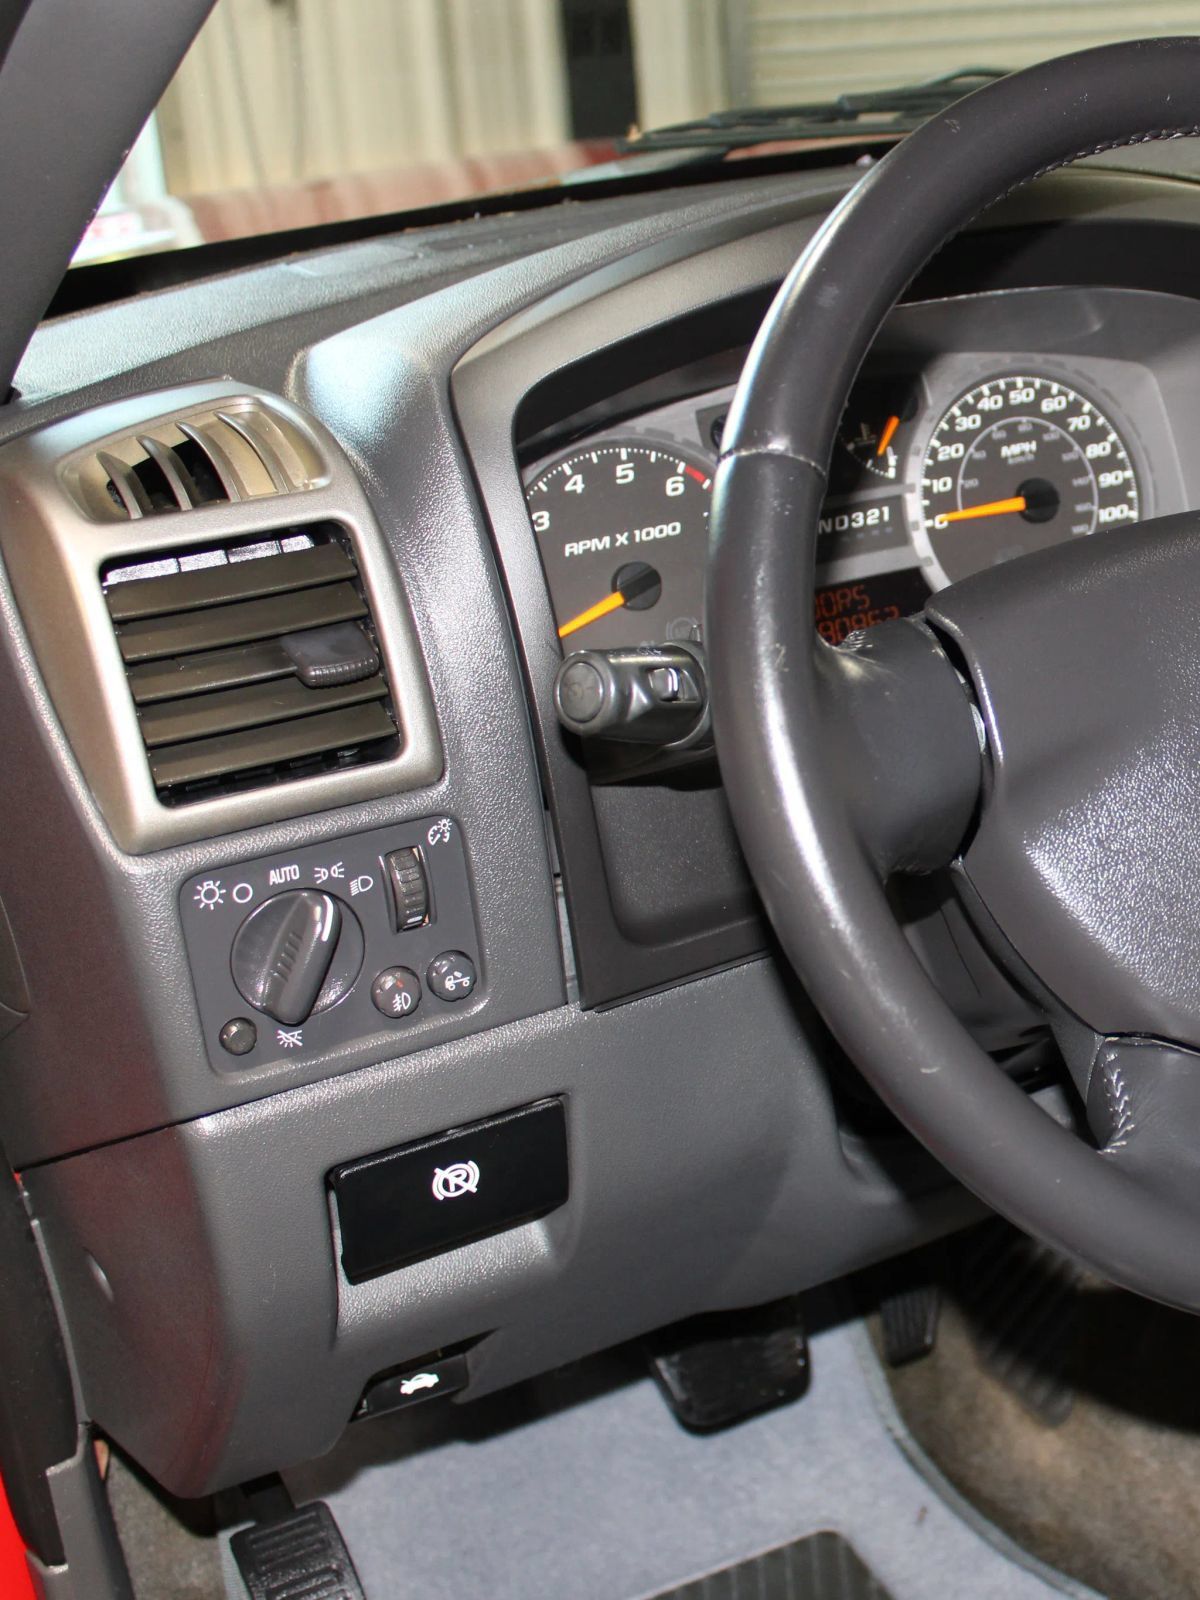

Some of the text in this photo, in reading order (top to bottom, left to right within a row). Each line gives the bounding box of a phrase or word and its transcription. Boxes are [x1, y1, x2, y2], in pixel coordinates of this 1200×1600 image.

[977, 394, 1003, 411] 40
[1009, 387, 1035, 405] 50
[1041, 396, 1067, 413] 60
[955, 414, 981, 432] 30
[1067, 414, 1091, 432] 70
[937, 443, 964, 461] 20
[1001, 440, 1037, 459] MPH
[1085, 442, 1111, 459] 80
[616, 462, 635, 484] 5
[1098, 470, 1124, 488] 90
[564, 474, 585, 494] 4
[665, 476, 685, 497] 6
[931, 477, 953, 494] 10
[531, 510, 550, 531] 3
[1098, 504, 1129, 523] 100
[564, 521, 681, 558] RPM X 1000
[269, 864, 300, 886] AUTO
